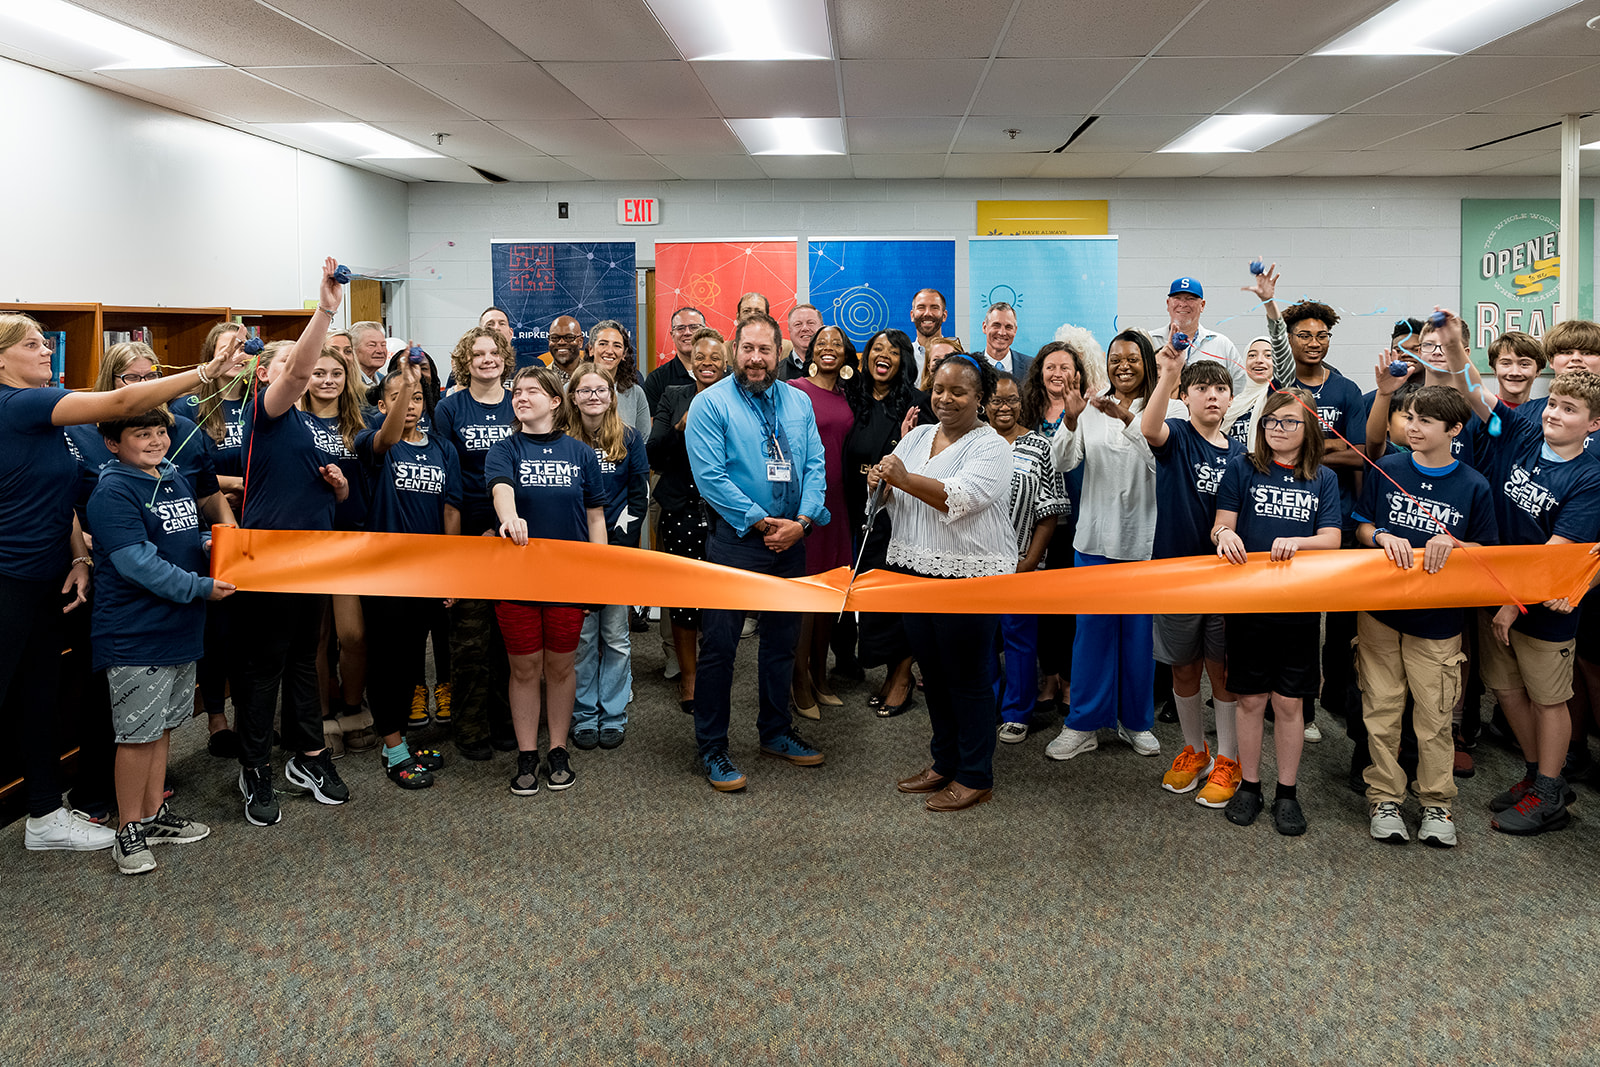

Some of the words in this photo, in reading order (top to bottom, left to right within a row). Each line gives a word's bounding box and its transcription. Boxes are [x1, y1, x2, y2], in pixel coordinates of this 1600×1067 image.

[624, 199, 654, 222] EXIT
[1484, 230, 1497, 249] THE
[1494, 213, 1527, 230] WHOLE
[1181, 278, 1190, 289] S
[1494, 281, 1519, 302] WHEN
[1527, 282, 1560, 303] LEARNE
[465, 427, 513, 440] STEM
[465, 438, 505, 449] CENT
[396, 464, 443, 483] STEM
[520, 462, 571, 476] STEM
[395, 478, 442, 492] CENTER
[520, 474, 572, 485] CENTER
[1255, 488, 1312, 510] STEM
[158, 500, 197, 520] STEM
[1254, 502, 1310, 520] CENTER
[1391, 495, 1451, 524] STEM
[1389, 510, 1447, 534] CENTER
